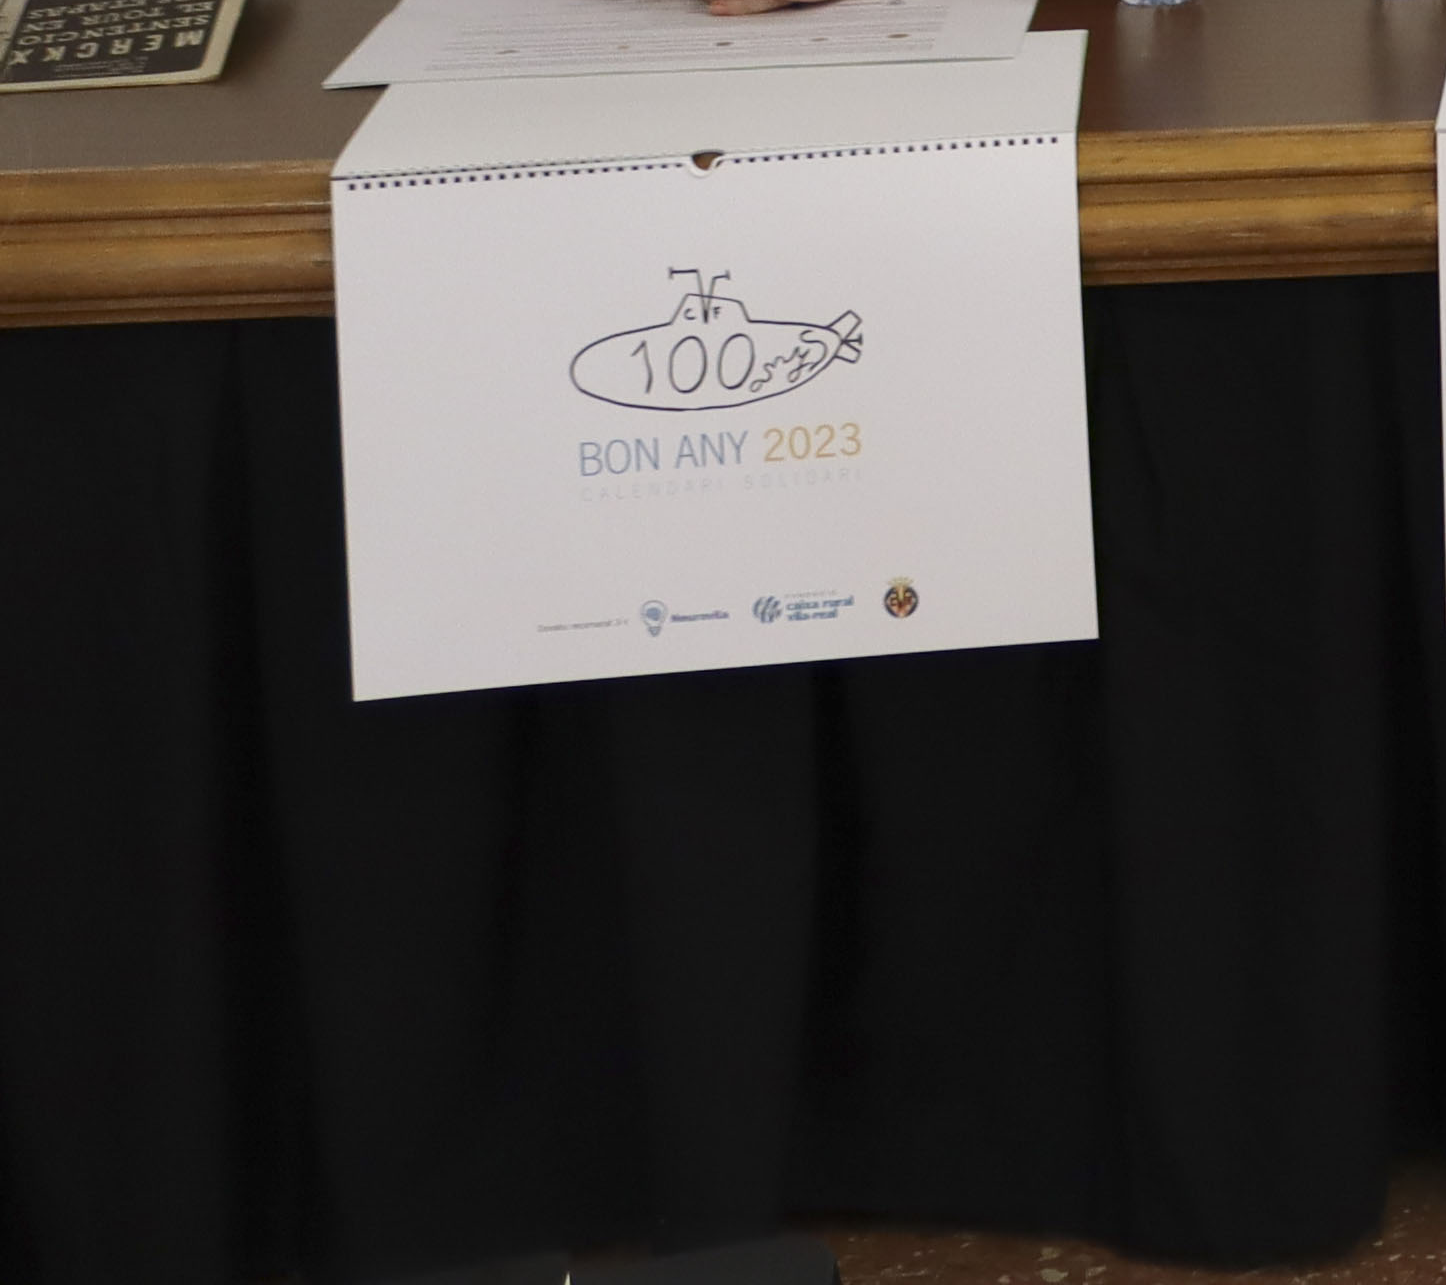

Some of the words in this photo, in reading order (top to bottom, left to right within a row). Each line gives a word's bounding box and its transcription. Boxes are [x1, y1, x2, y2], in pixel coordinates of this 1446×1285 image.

[8, 29, 205, 66] MERCKX
[579, 436, 661, 478] BON
[674, 429, 749, 470] ANY
[762, 422, 863, 463] 2023
